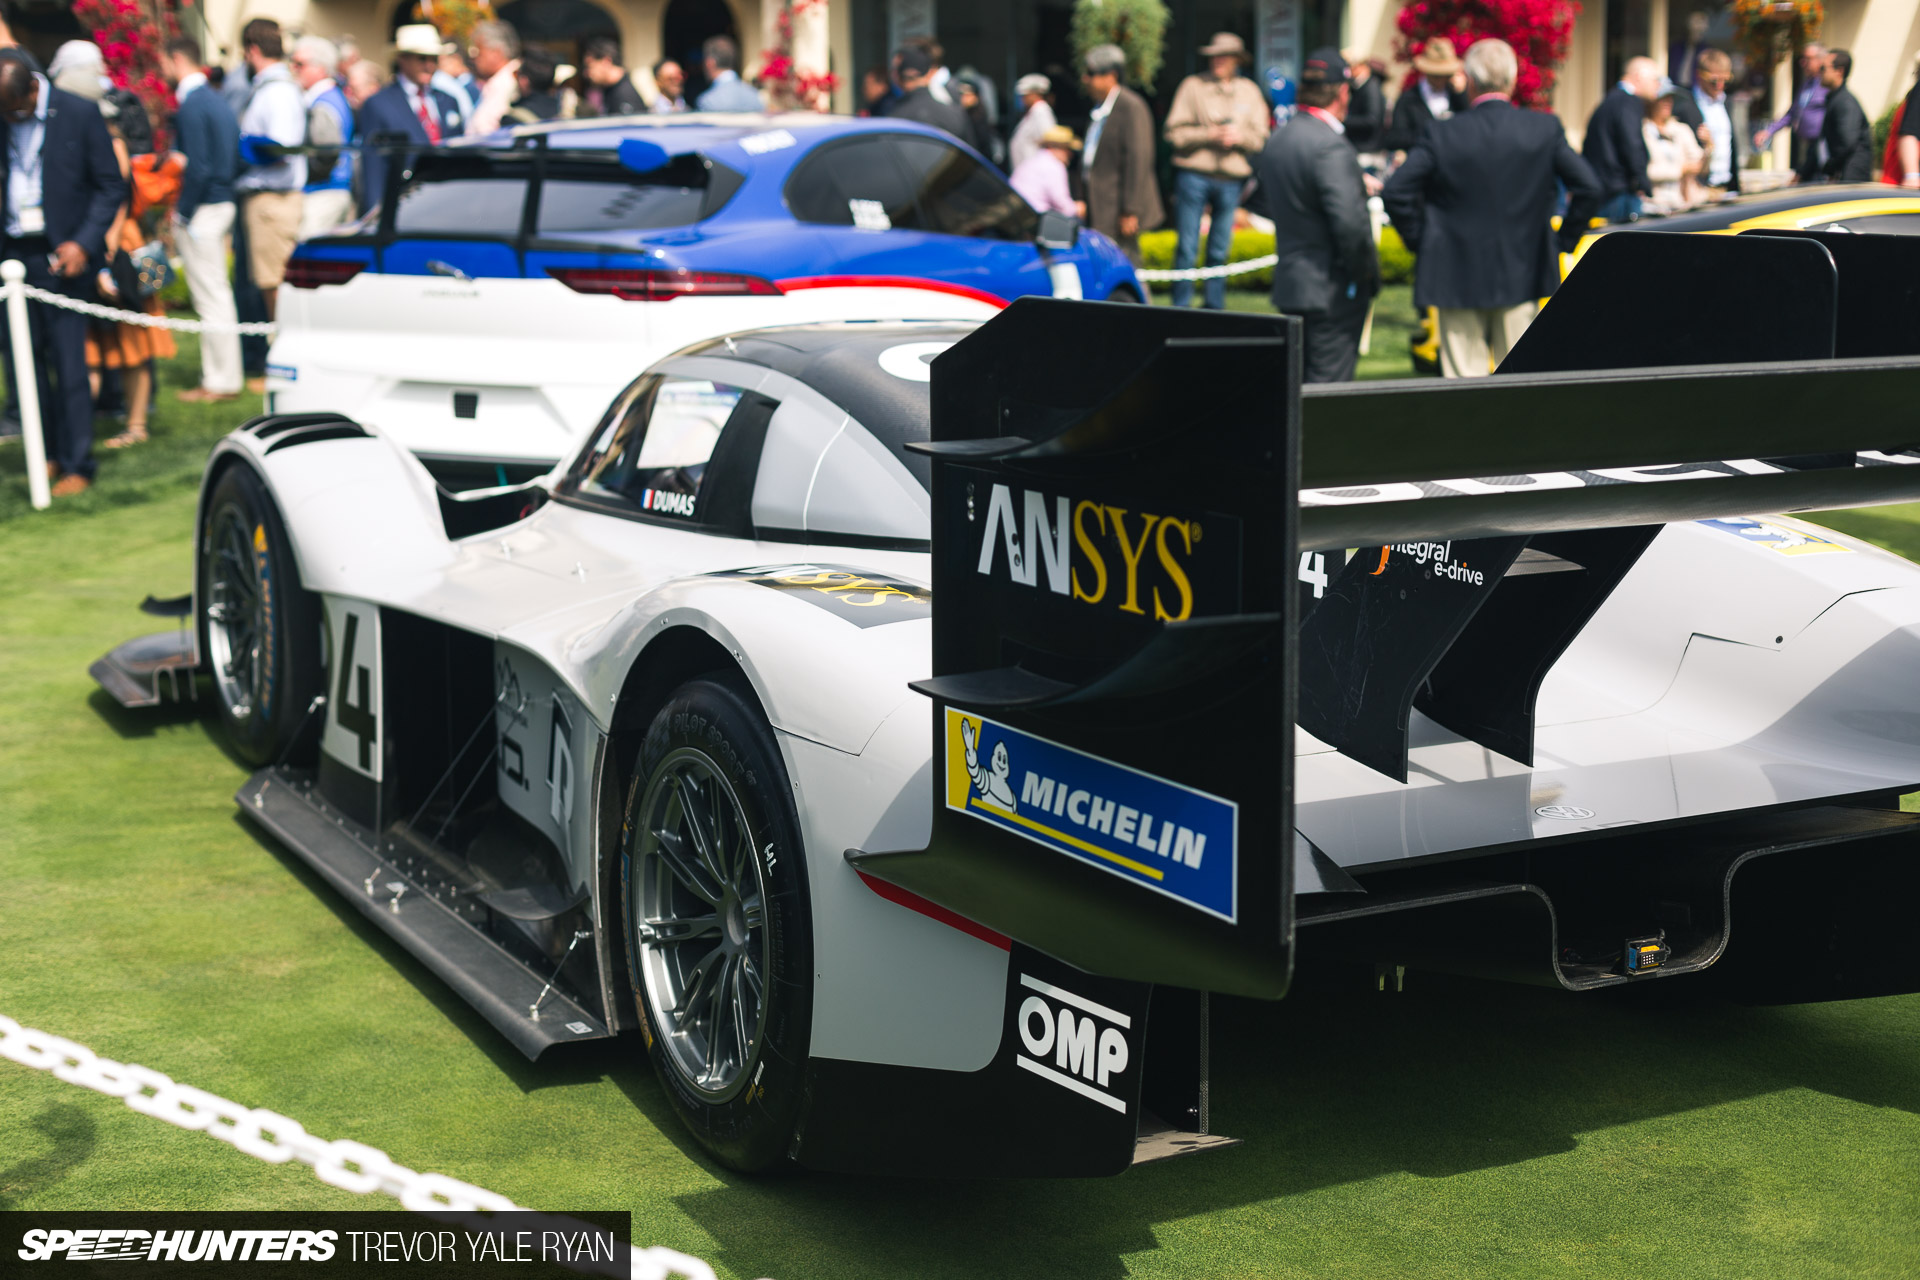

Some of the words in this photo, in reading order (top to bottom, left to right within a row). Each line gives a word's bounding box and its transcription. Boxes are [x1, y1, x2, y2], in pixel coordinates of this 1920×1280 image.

[652, 489, 697, 517] DUMAS
[1434, 560, 1484, 586] e-drive
[674, 712, 708, 737] PILOT
[707, 725, 746, 778] SPORT
[1021, 770, 1207, 870] MICHELIN
[1018, 995, 1129, 1088] OMP
